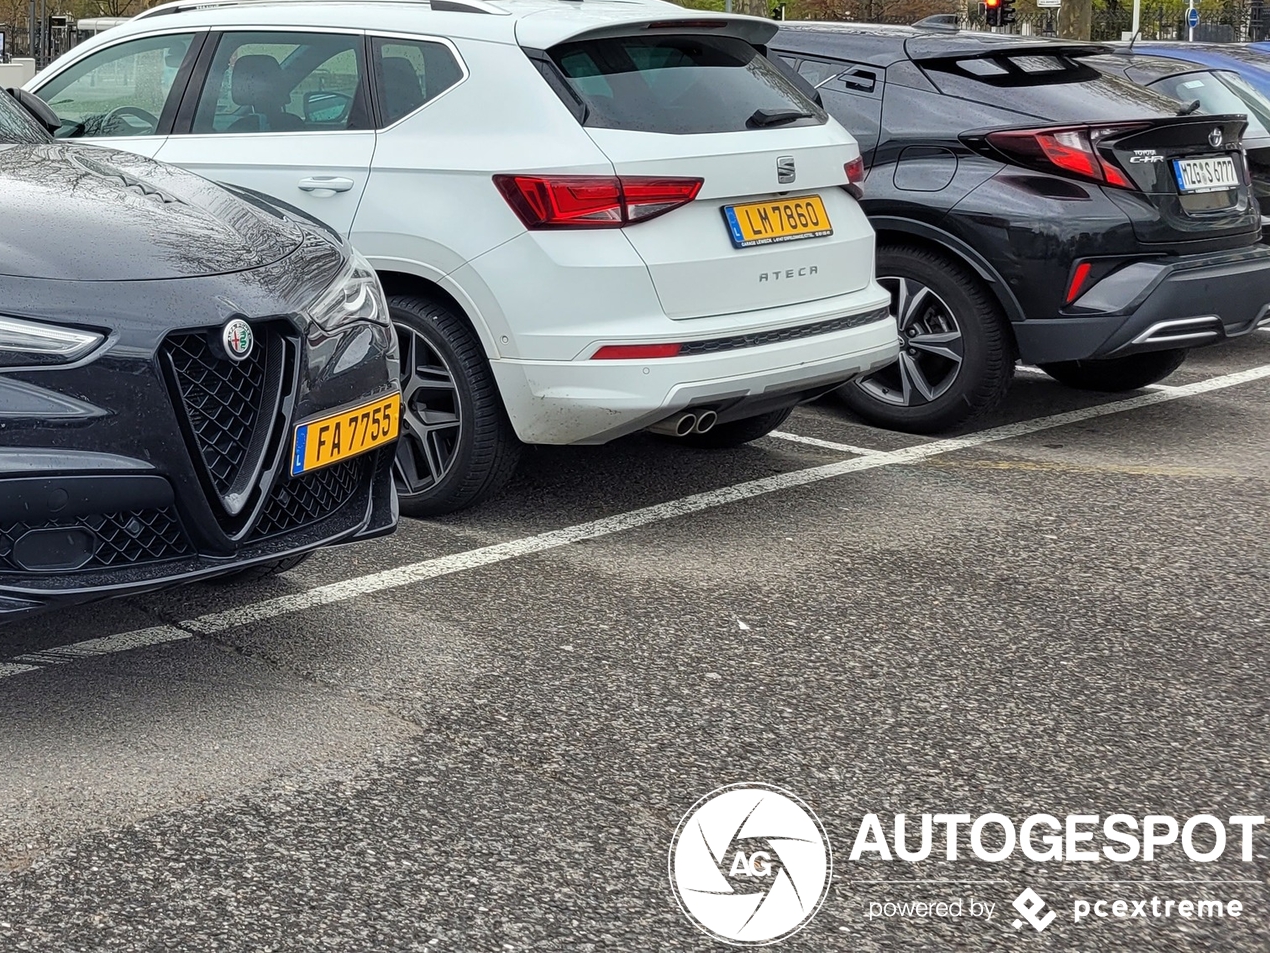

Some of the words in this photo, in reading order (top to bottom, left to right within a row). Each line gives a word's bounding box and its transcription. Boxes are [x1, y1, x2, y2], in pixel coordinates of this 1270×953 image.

[1130, 156, 1164, 164] C-HR
[745, 208, 774, 235] LM
[771, 202, 819, 231] 7860
[759, 266, 818, 282] ATECA
[316, 422, 341, 461] FA
[348, 403, 392, 451] 7755
